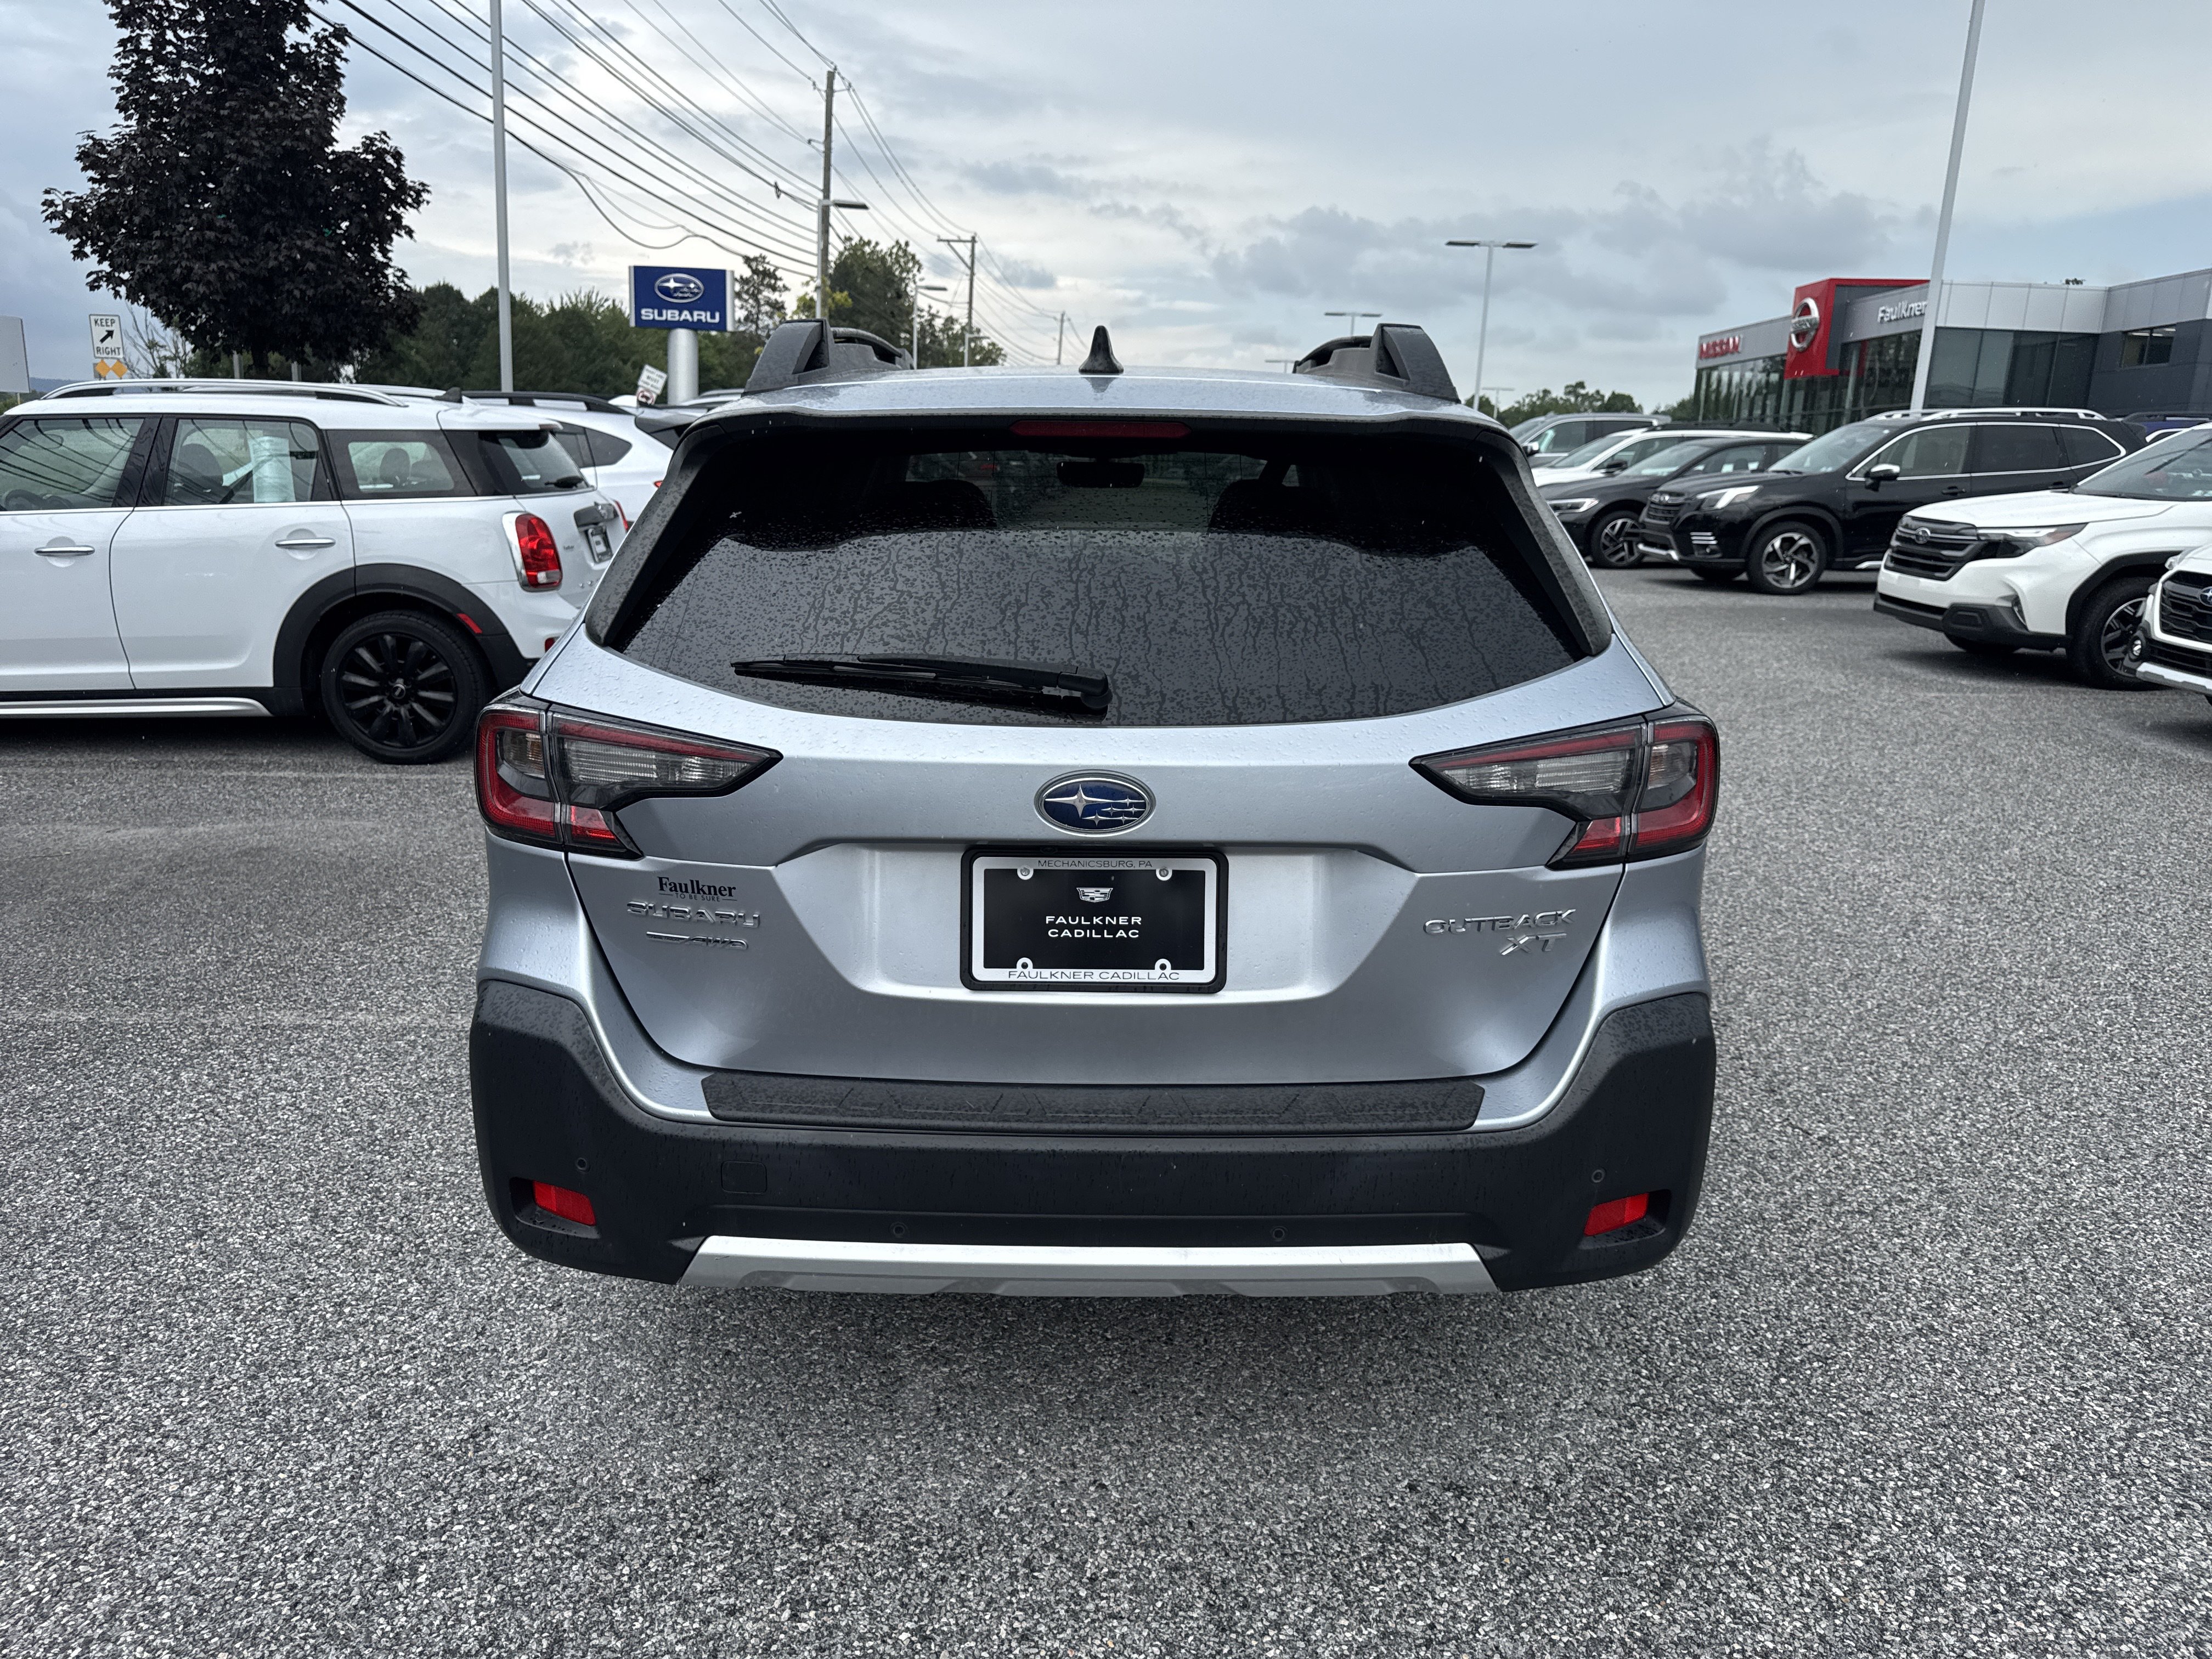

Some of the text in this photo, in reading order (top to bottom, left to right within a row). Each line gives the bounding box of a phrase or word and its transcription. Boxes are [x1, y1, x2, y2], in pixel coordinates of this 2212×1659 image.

[640, 307, 720, 324] SUBARU
[1877, 300, 1928, 323] Faulkner
[94, 318, 115, 328] KEEP
[96, 346, 121, 356] RIGHT
[1038, 860, 1153, 869] MECHANICSBURG, PA
[657, 876, 736, 897] Faulkner
[627, 900, 761, 928] SUBARU
[1046, 916, 1142, 925] FAULKNER
[1423, 909, 1576, 934] OUTBACK
[1047, 929, 1139, 938] CADILLAC
[685, 935, 748, 950] AWD
[1500, 932, 1567, 956] XT
[1008, 970, 1180, 980] FAULKNER CADILLAC
